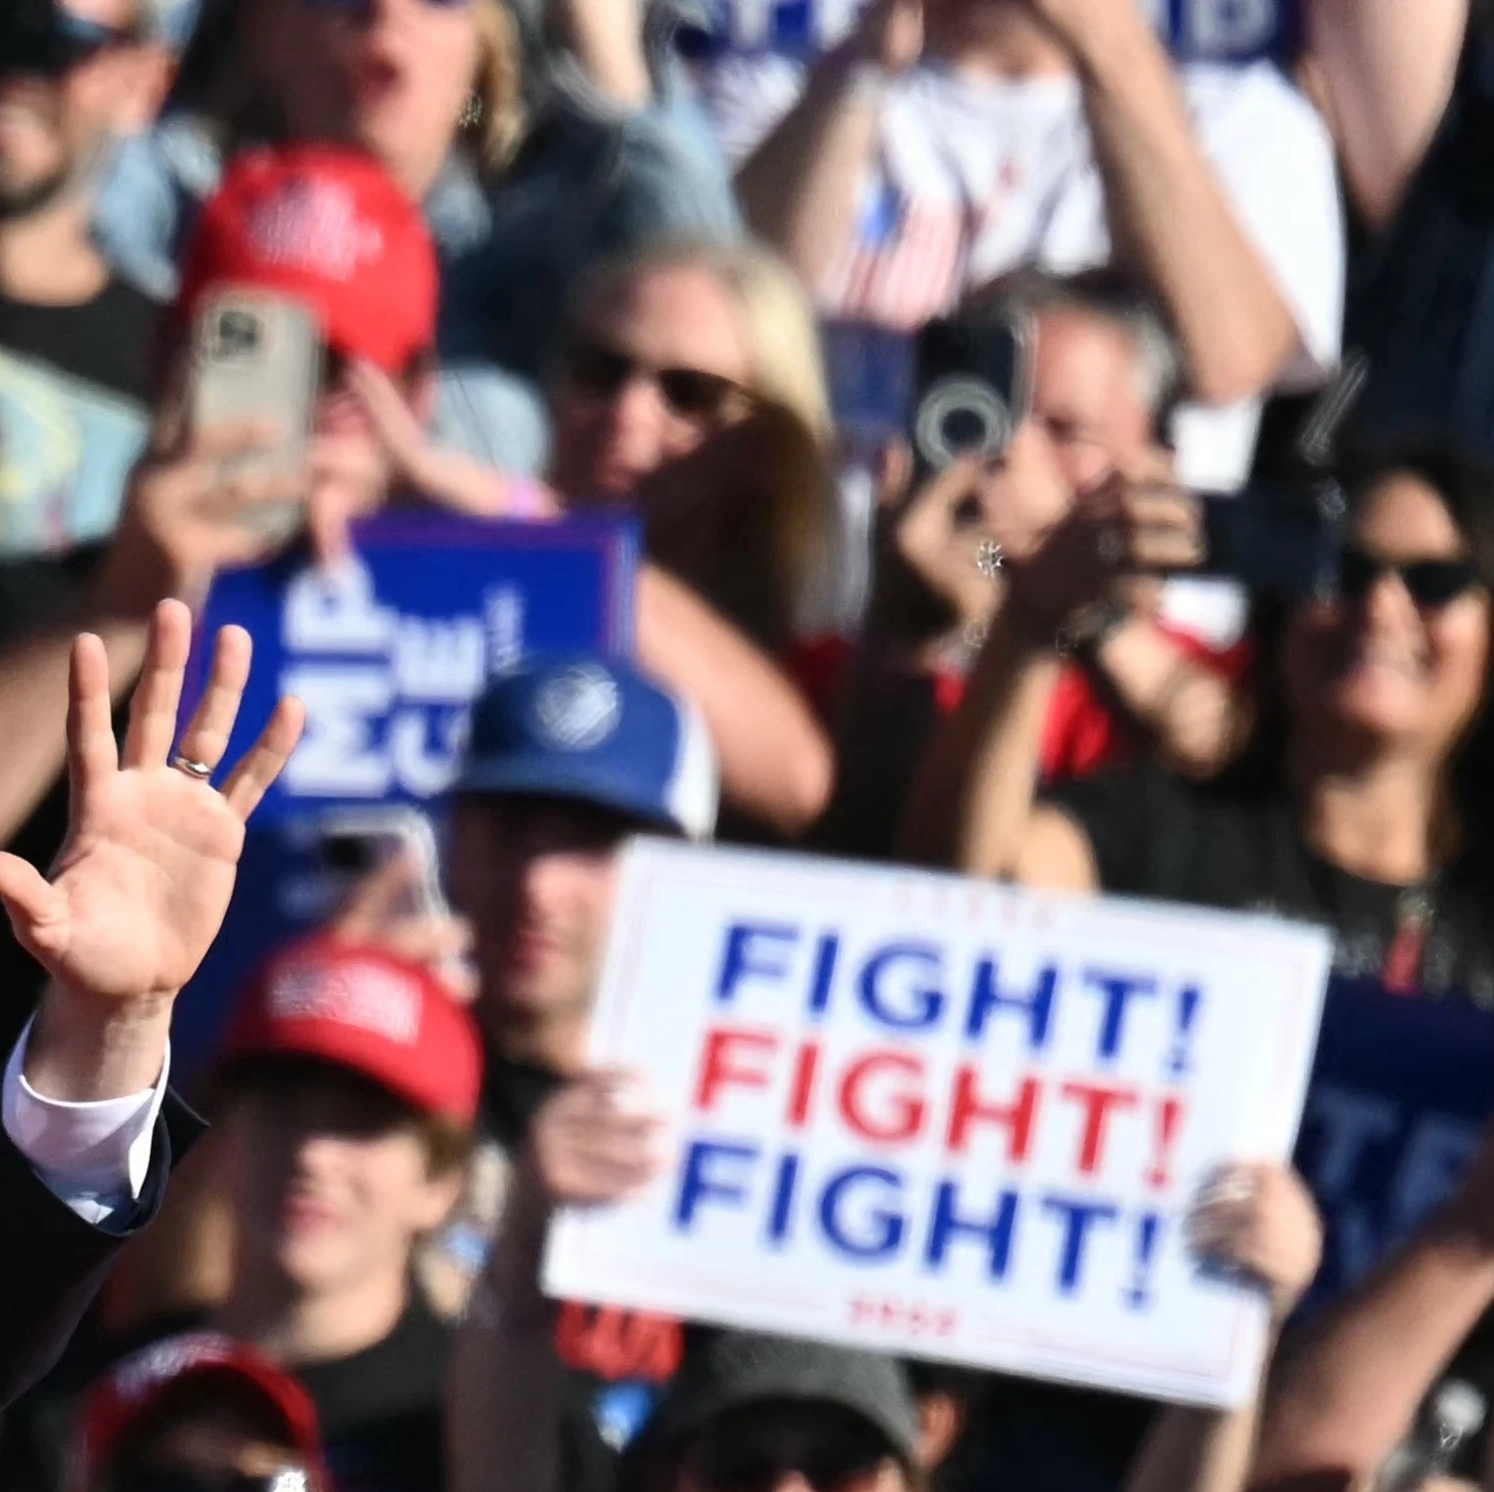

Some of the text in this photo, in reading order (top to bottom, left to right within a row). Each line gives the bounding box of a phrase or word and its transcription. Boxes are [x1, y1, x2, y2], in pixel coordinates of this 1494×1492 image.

[712, 917, 1202, 1074] FIGHT!
[690, 1025, 1185, 1190] FIGHT!
[671, 1139, 1161, 1307] FIGHT!
